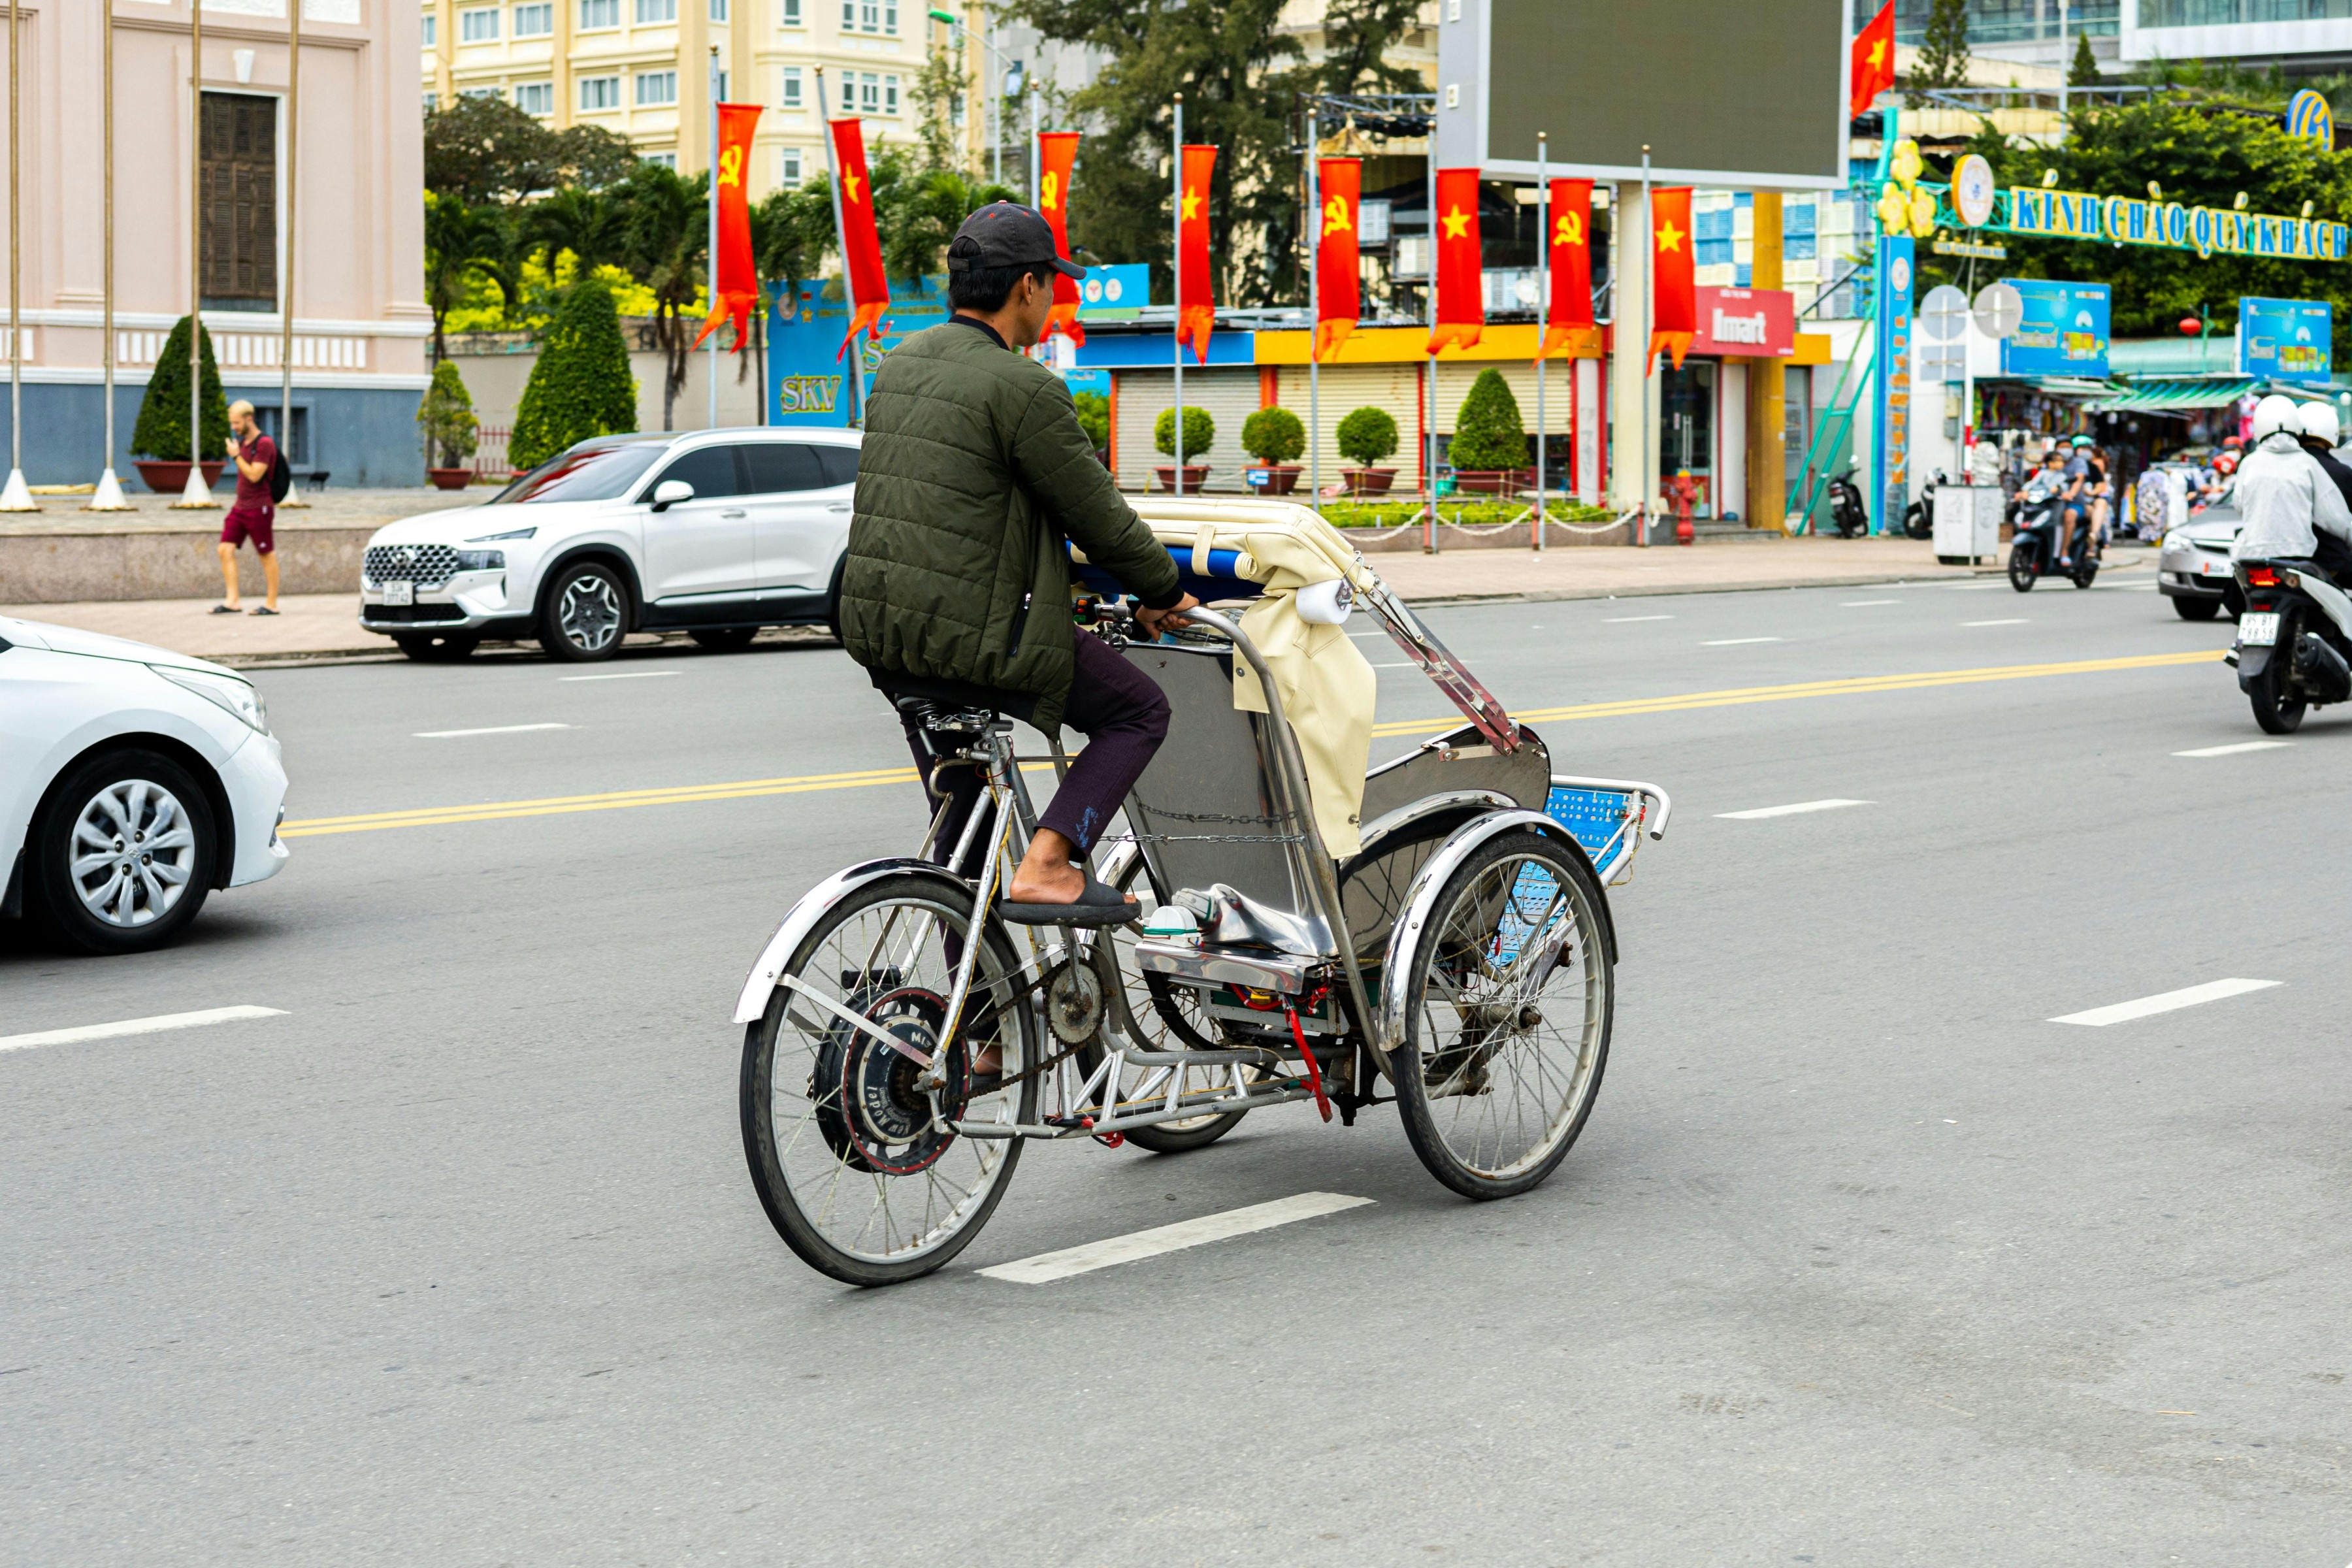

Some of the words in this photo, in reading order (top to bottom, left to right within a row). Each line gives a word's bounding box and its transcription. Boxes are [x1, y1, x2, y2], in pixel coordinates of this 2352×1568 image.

[2010, 169, 2100, 238] KÍNH
[2103, 180, 2185, 246] CHÀO
[2190, 191, 2251, 259] QUÝ
[2253, 200, 2349, 260] KHÁCH
[867, 1086, 890, 1126] Model
[879, 1087, 889, 1110] Taiwan
[887, 1122, 911, 1136] New
